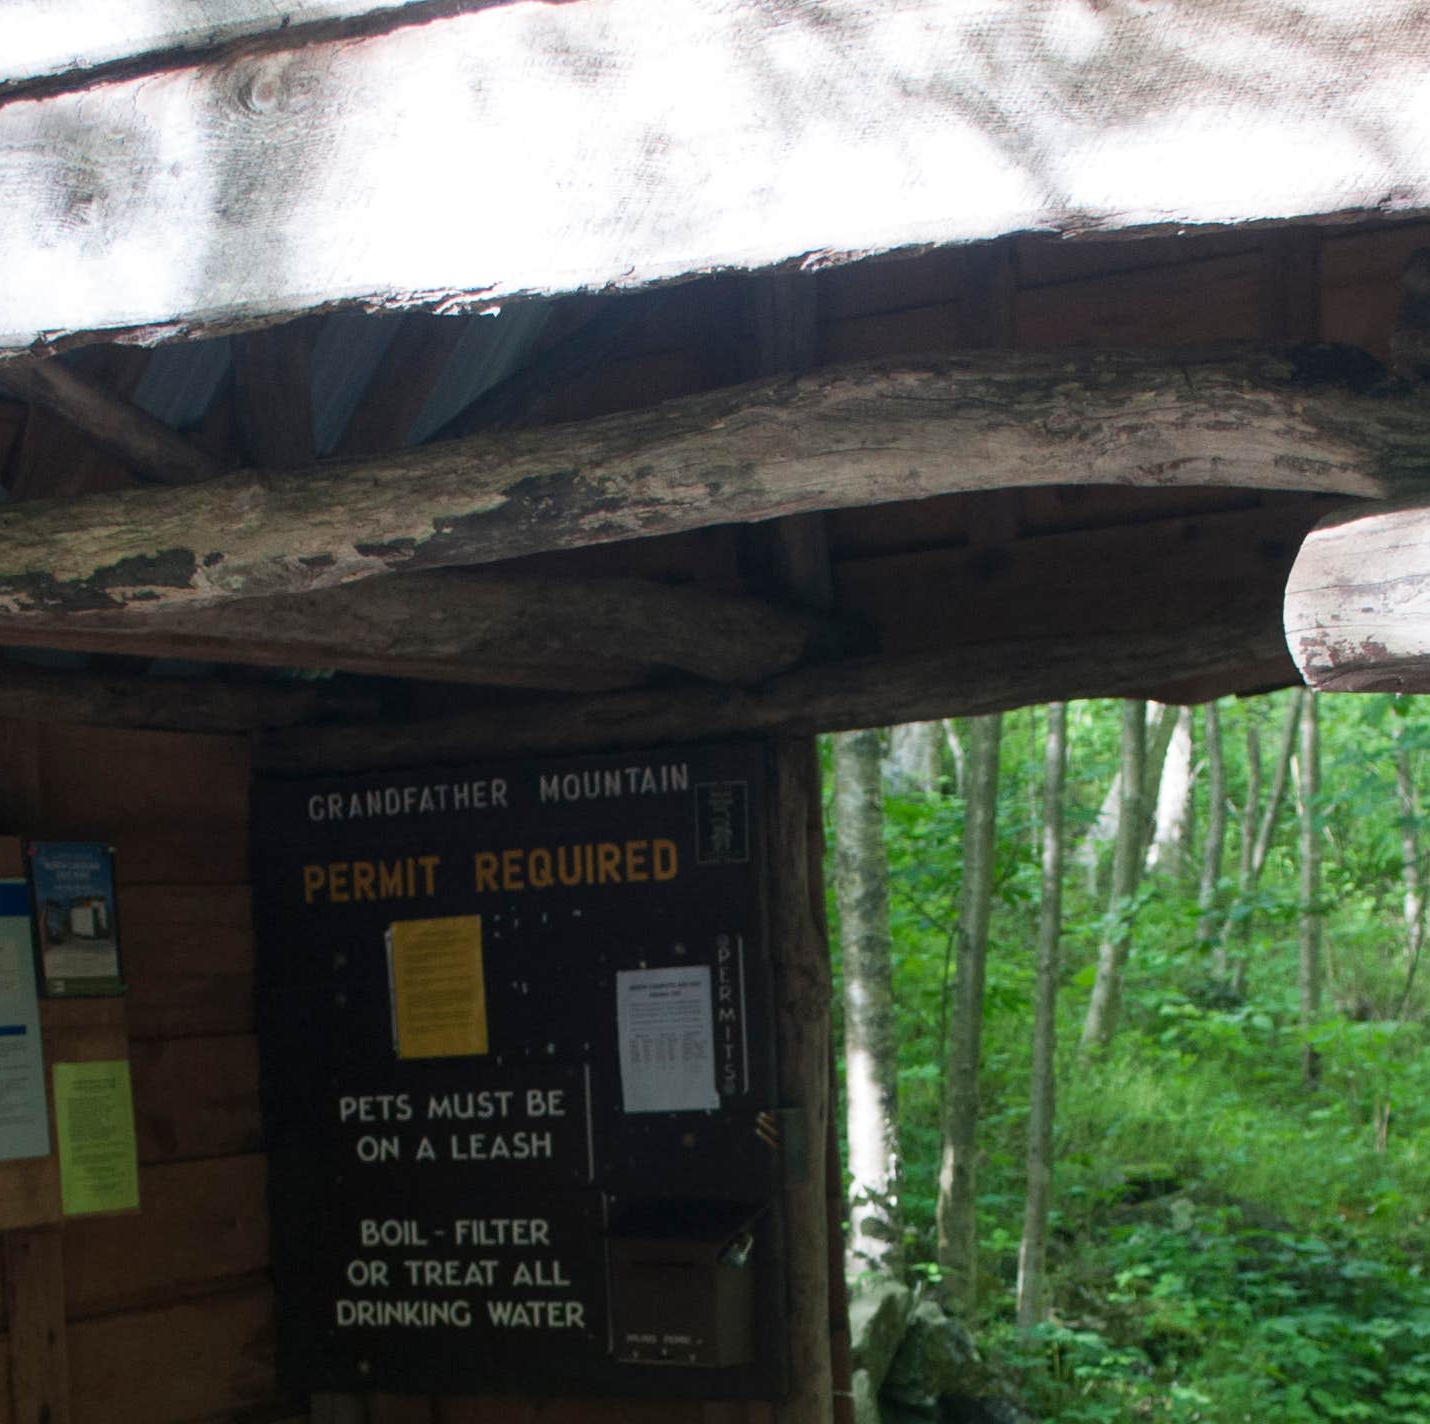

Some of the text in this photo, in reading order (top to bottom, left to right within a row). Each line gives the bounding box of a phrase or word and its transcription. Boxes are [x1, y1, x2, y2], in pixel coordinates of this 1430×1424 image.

[308, 764, 690, 821] GRANDFATHER MOUNTAIN
[303, 838, 679, 904] PERMIT REQUIRED
[717, 947, 736, 1080] PERMITS
[340, 1089, 565, 1122] PETS MUST BE
[357, 1132, 552, 1162] ON A LEASH
[361, 1220, 428, 1246] BOIL
[455, 1219, 550, 1246] FILTER
[347, 1260, 571, 1286] OR TREAT ALL
[336, 1299, 586, 1328] DRINKING WATER
